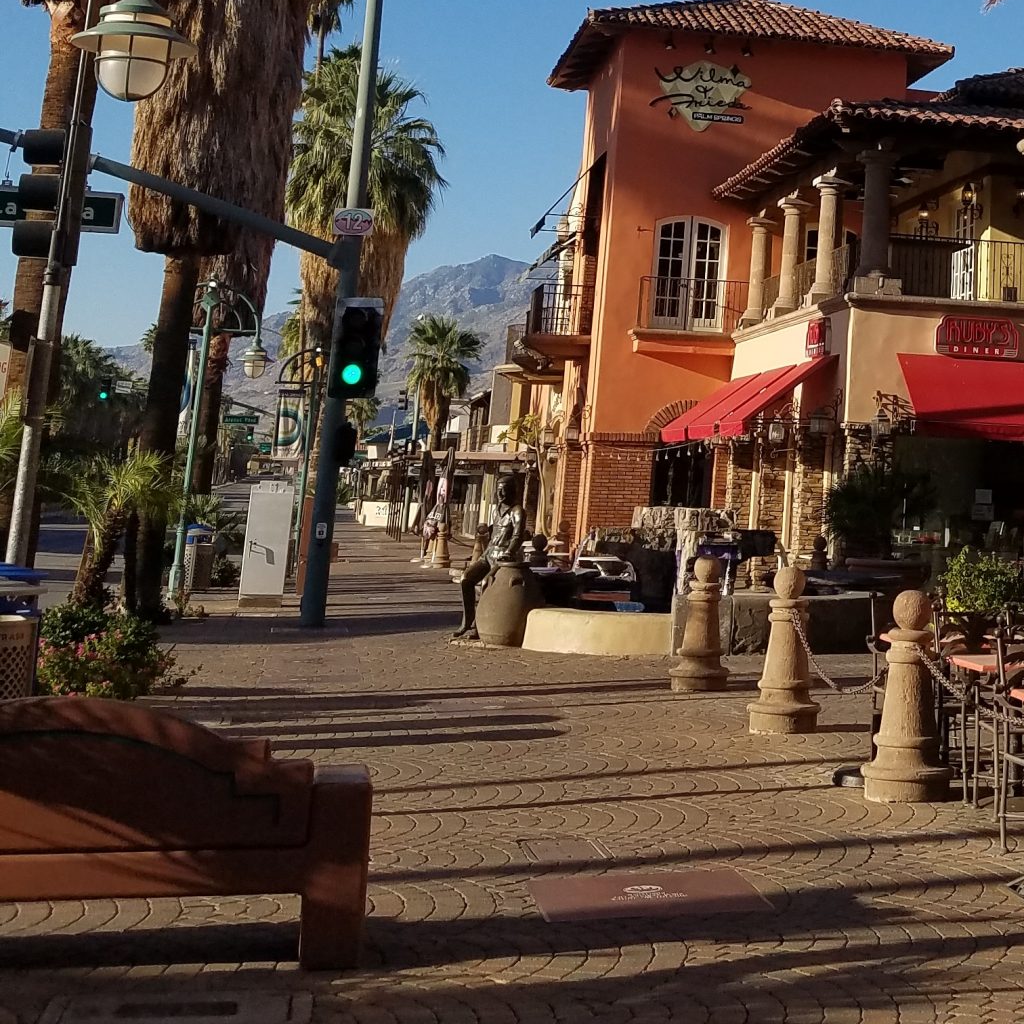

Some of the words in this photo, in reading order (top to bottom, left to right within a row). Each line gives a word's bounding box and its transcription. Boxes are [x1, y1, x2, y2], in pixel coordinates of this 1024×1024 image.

[655, 66, 752, 88] Wilma
[345, 212, 363, 231] 12
[953, 345, 1000, 355] DINER
